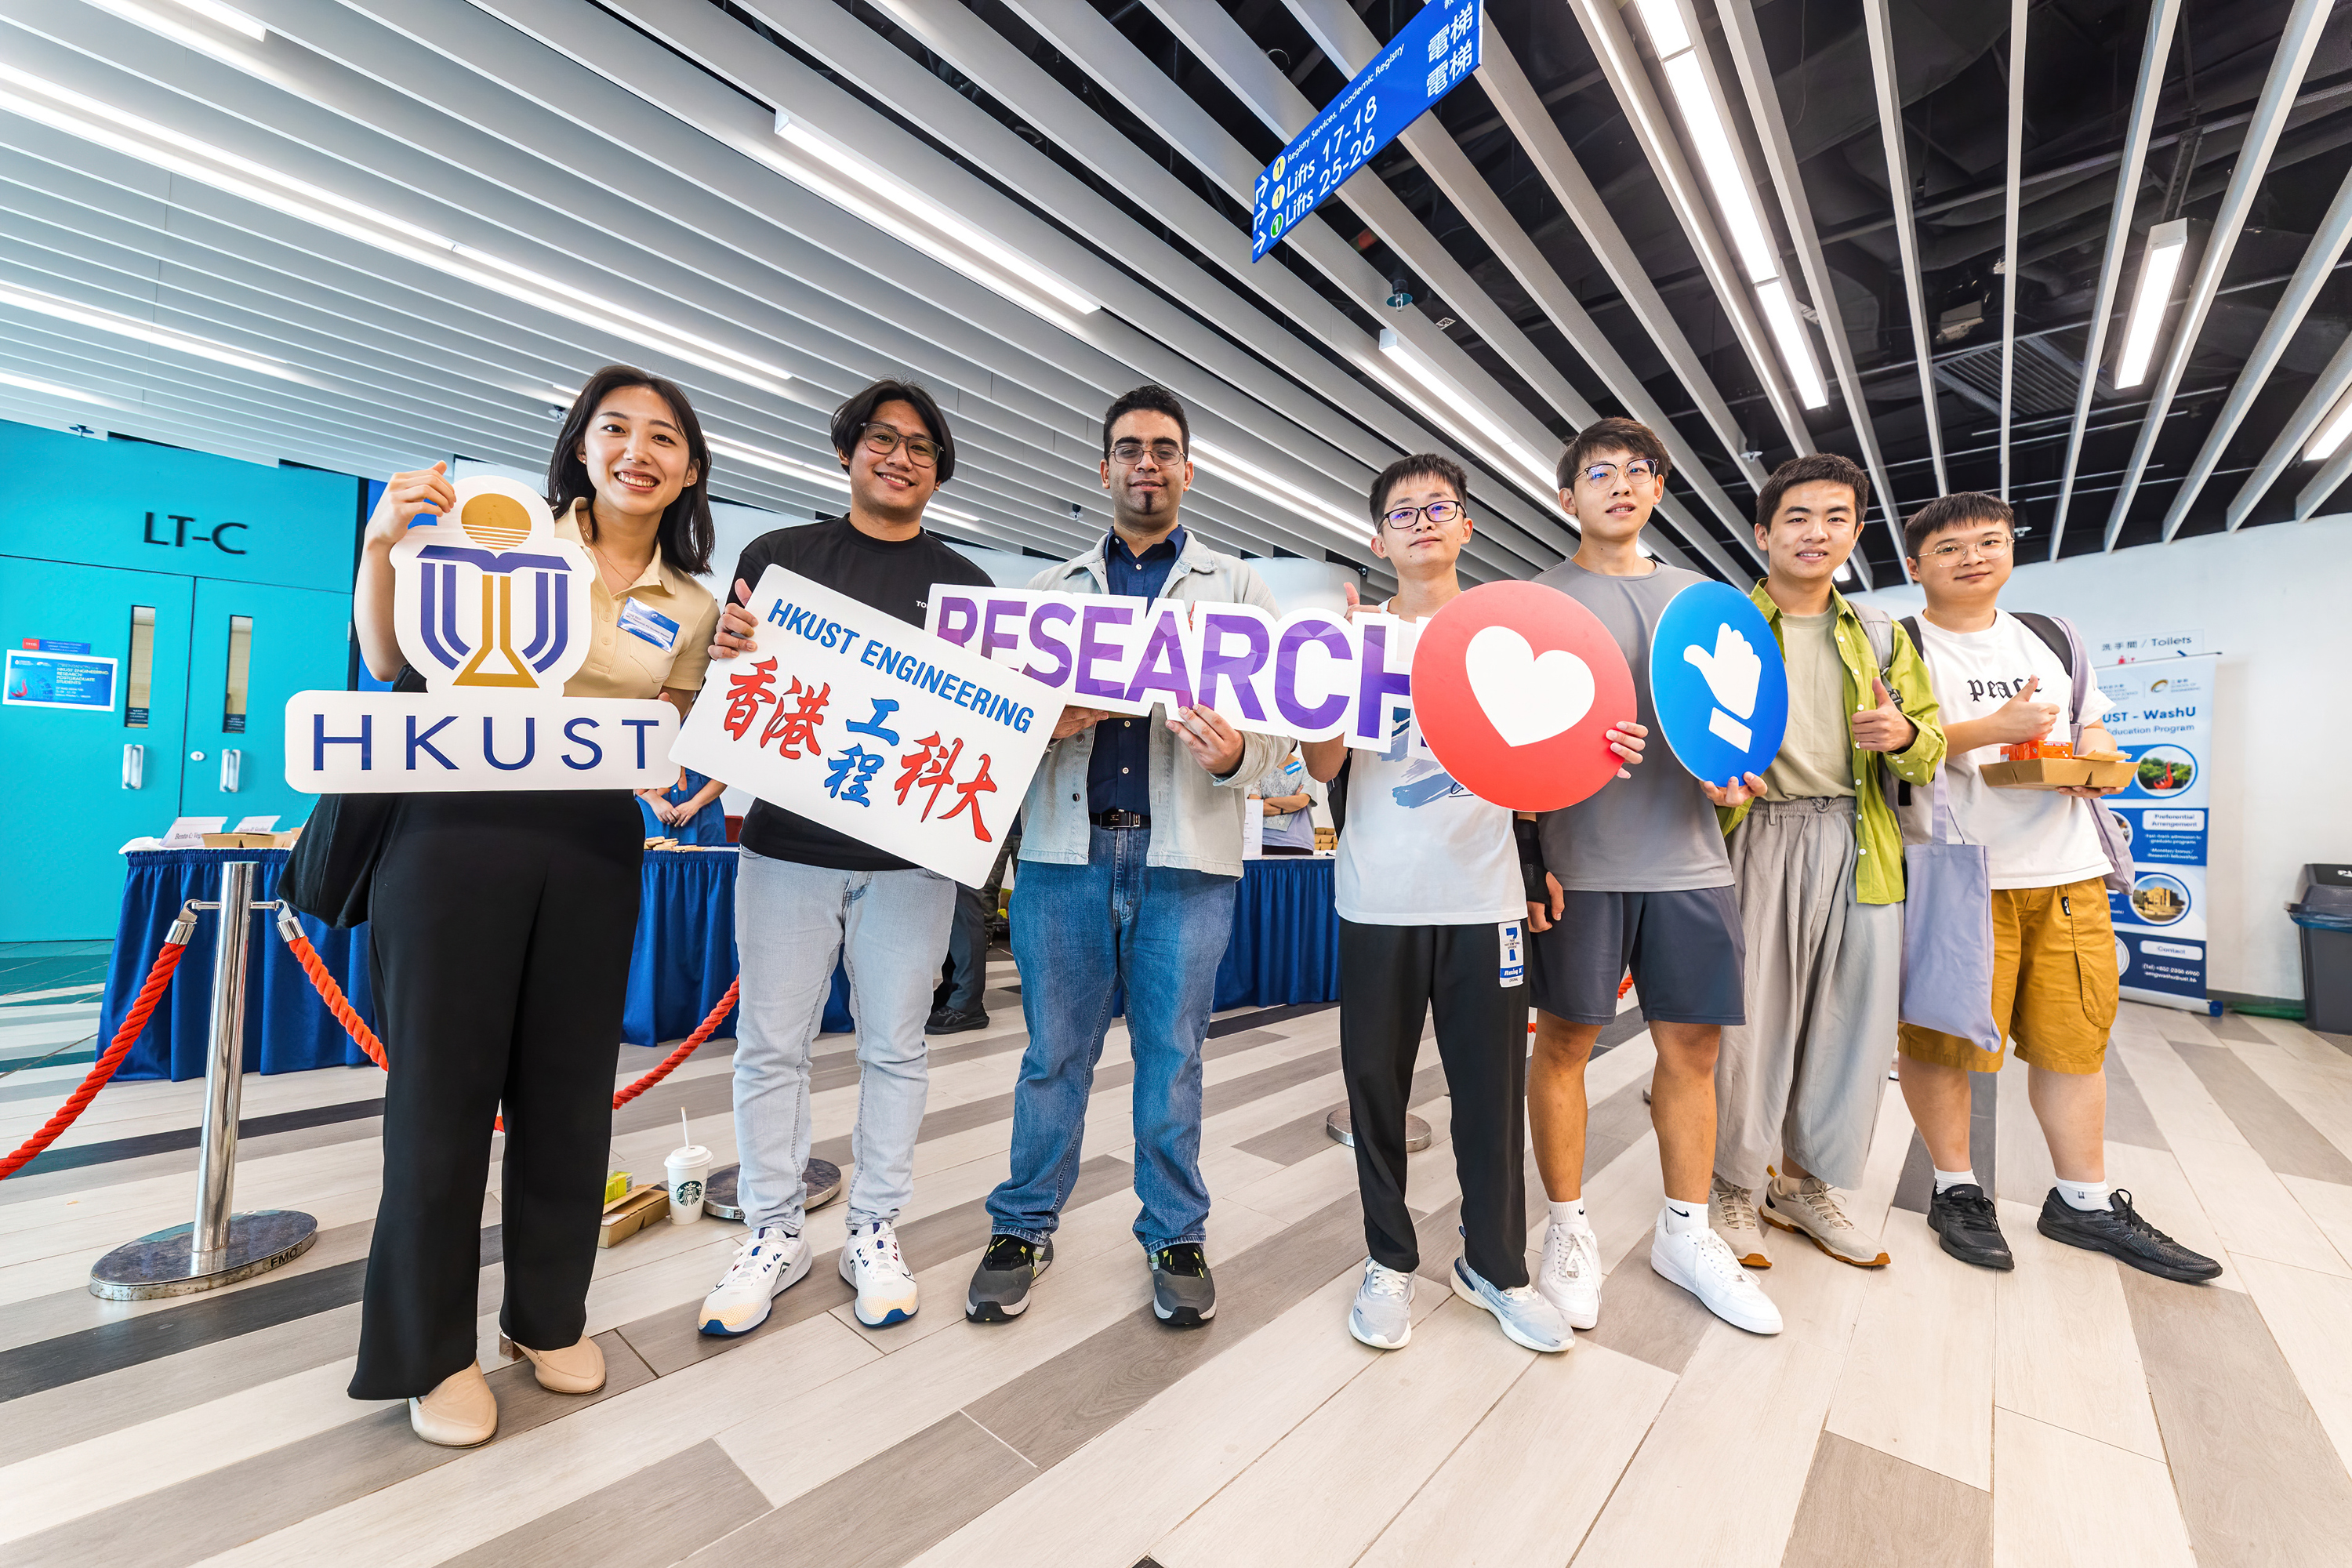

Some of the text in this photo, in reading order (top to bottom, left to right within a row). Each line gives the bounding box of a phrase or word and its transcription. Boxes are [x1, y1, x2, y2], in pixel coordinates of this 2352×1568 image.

[1428, 2, 1472, 63] 電梯
[1427, 38, 1472, 97] 電梯
[1287, 137, 1310, 163] Registry
[1339, 74, 1374, 113] Academic
[1375, 43, 1404, 77] Registry
[1287, 159, 1315, 198] Lifts
[1323, 96, 1377, 162] 17-18
[1286, 189, 1313, 227] Lifts
[1319, 127, 1375, 197] 25-26
[144, 512, 248, 554] LT-C
[768, 598, 1035, 734] HKUST ENGINEERING
[937, 596, 1427, 747] RESEARCH
[2102, 641, 2138, 652] 洗手間
[2151, 637, 2192, 647] Toilets
[1967, 678, 2043, 702] peac
[2144, 706, 2196, 720] WashU
[314, 714, 659, 771] HKUST
[2154, 724, 2194, 734] Program
[2158, 946, 2186, 954] Contact
